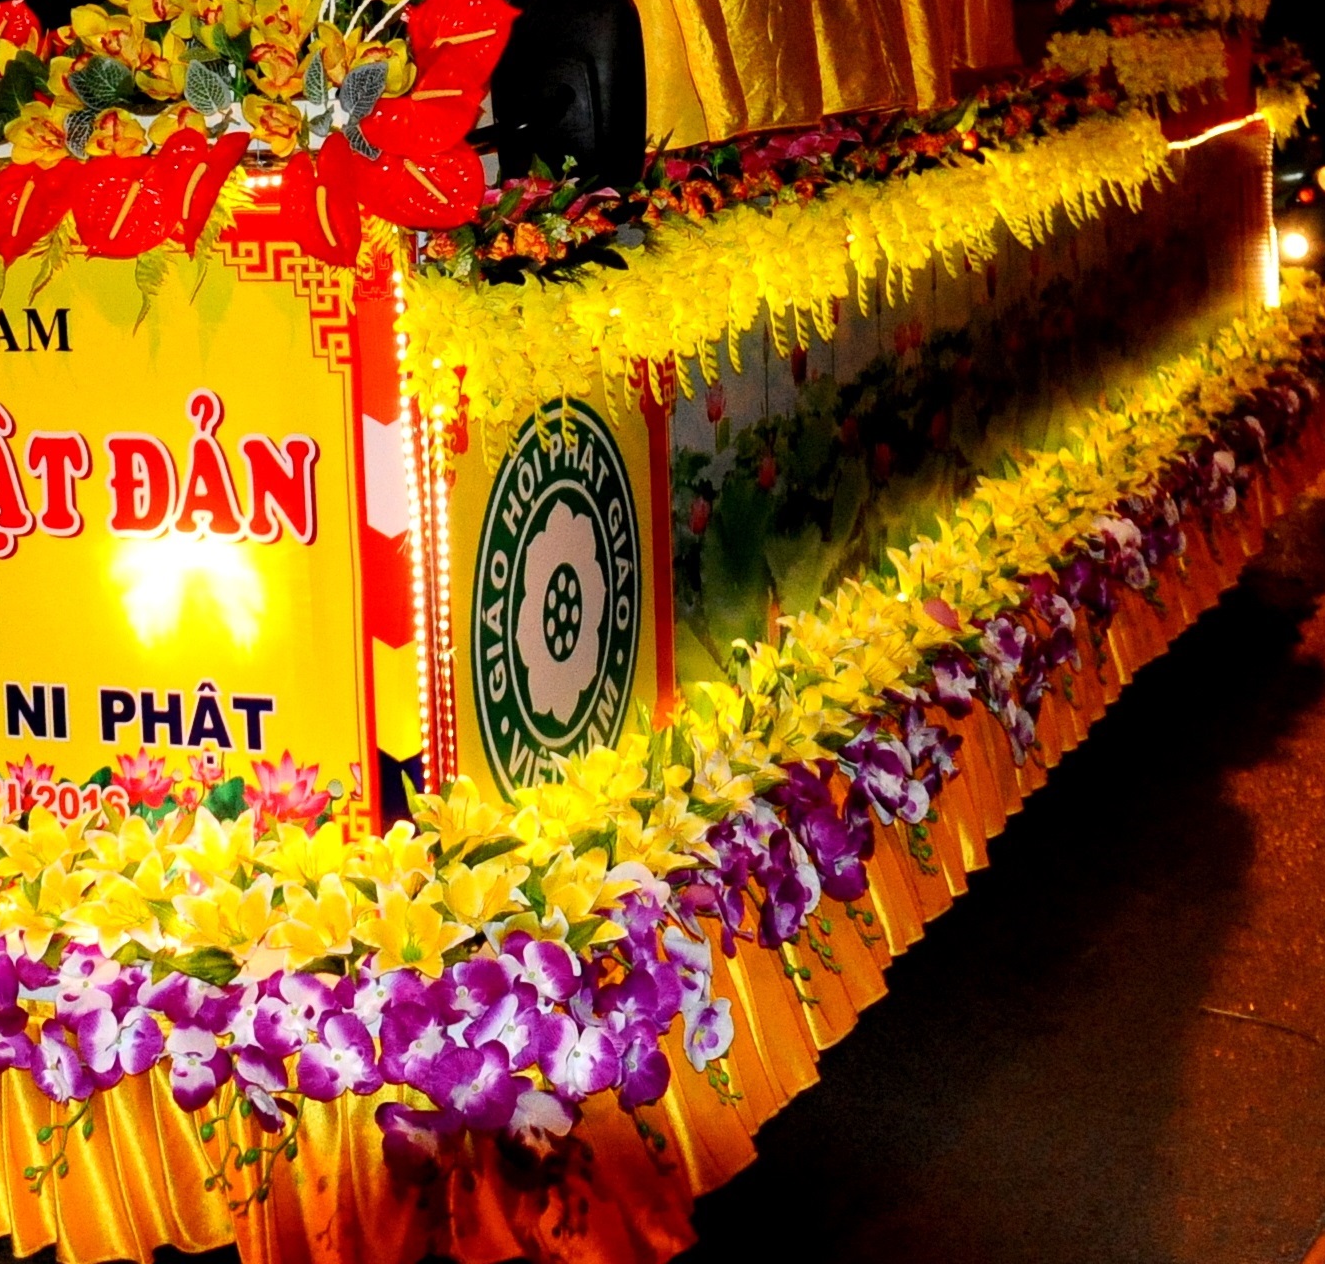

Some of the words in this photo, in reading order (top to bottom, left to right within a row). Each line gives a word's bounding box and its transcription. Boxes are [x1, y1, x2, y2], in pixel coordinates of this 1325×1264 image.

[107, 387, 319, 545] ĐẢN
[481, 549, 509, 703] GIÁO
[502, 448, 543, 536] HỘI
[549, 433, 610, 494] PHẬT
[607, 497, 633, 631] GIÁO
[5, 682, 69, 740] NI
[99, 681, 274, 766] PHẬT
